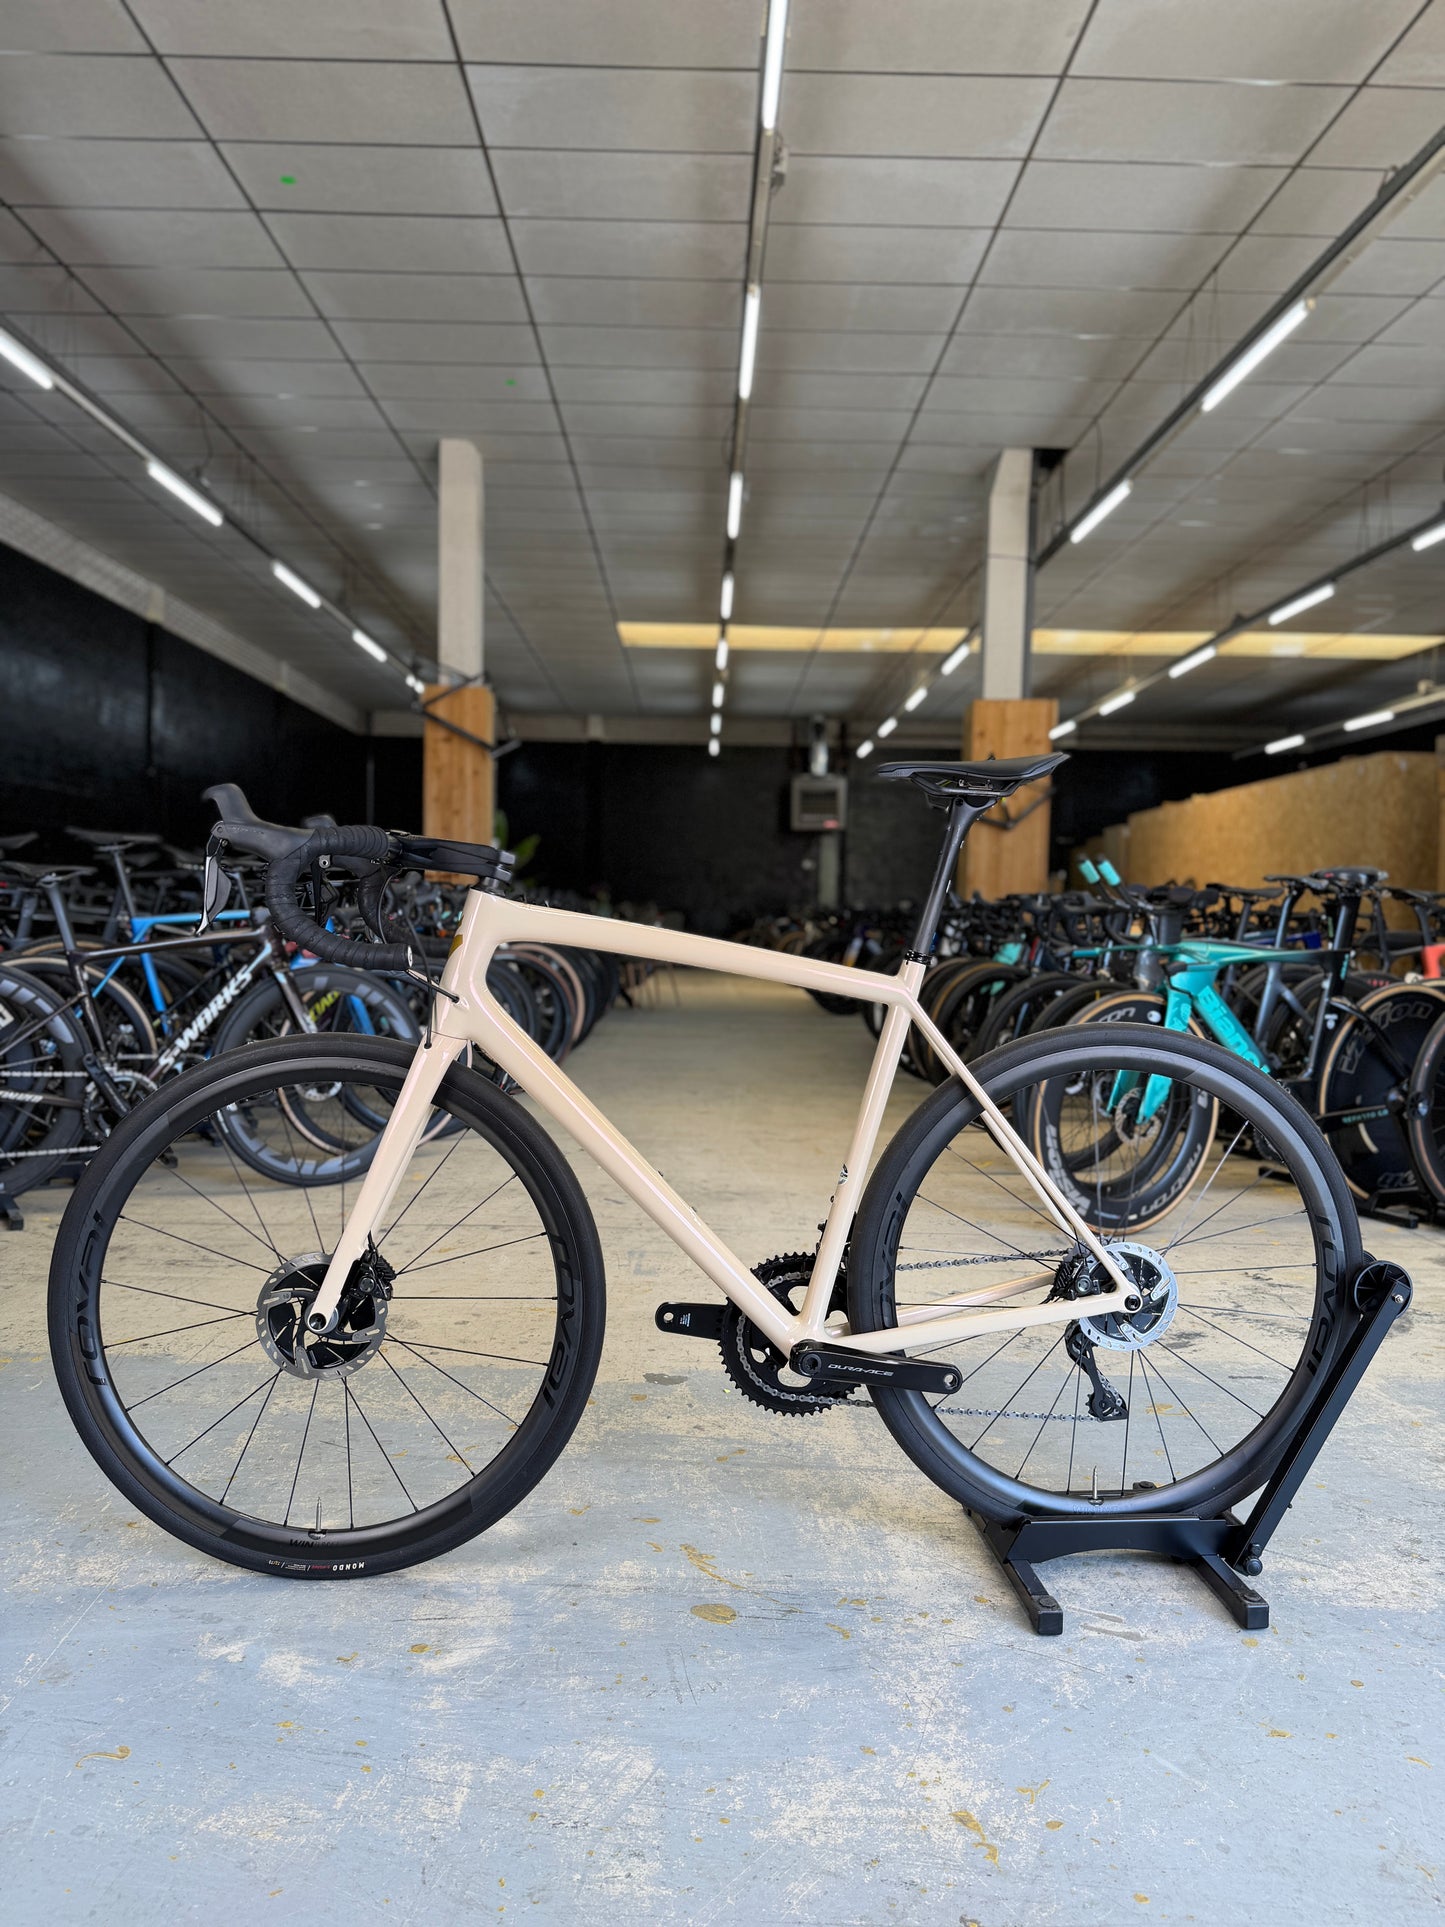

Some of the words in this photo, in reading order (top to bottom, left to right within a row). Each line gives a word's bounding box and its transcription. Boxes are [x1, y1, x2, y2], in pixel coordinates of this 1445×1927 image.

[158, 964, 252, 1069] S-WORKS
[1197, 985, 1271, 1074] Bianc
[827, 1363, 894, 1377] DURA-ACE
[332, 1561, 366, 1572] MONDO
